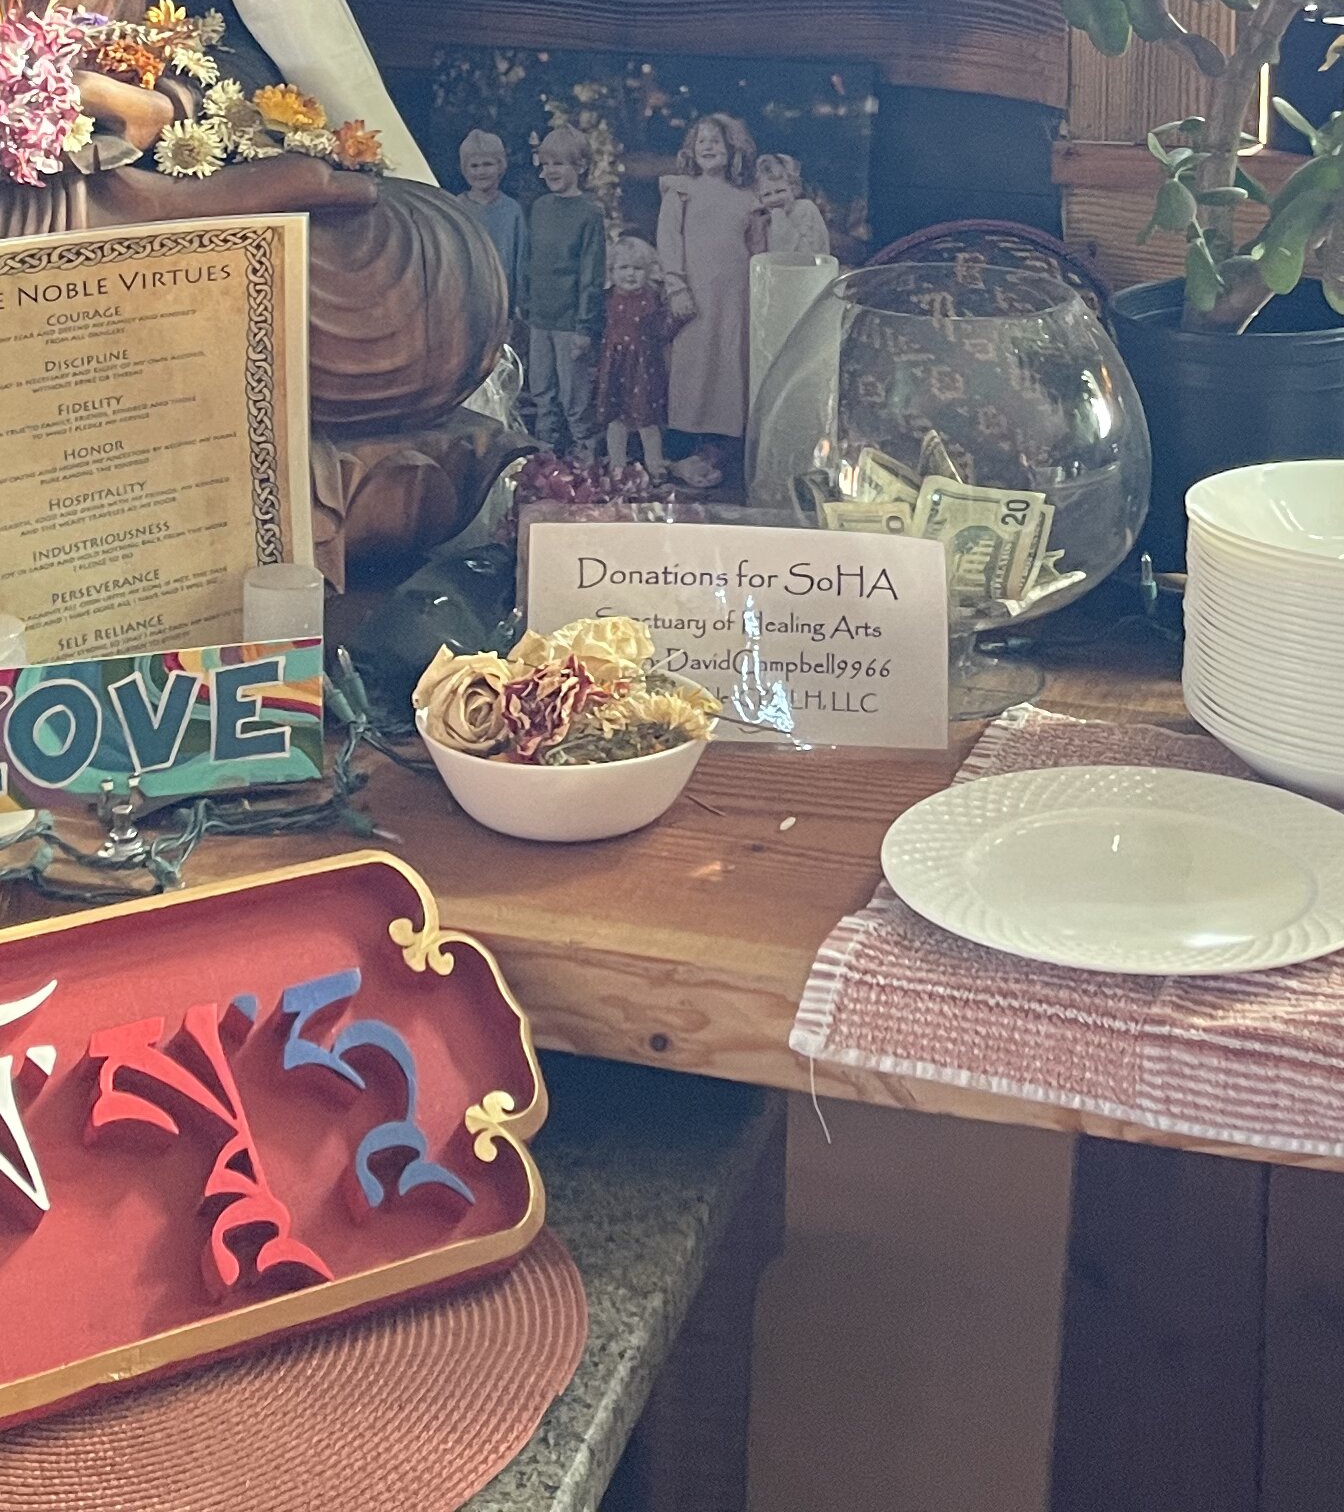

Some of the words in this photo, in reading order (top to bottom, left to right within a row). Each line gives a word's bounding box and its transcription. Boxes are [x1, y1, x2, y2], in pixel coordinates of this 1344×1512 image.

[17, 278, 107, 307] NOBLE
[118, 263, 232, 292] VIRTUES
[46, 305, 121, 327] COURAGE
[44, 348, 129, 373] DISCIPLINE
[57, 394, 124, 416] FIDELITY
[64, 440, 124, 462] HONOR
[48, 481, 147, 511] HOSPITALITY
[1001, 499, 1030, 527] 20
[32, 520, 170, 563] INDUSTRIOUSNESS
[51, 569, 160, 605] PERSEVERANCE
[577, 557, 728, 590] Donations
[736, 560, 779, 589] for
[783, 563, 899, 601] SoHA
[58, 632, 89, 652] SELF
[94, 614, 165, 642] RELIANCE
[713, 610, 735, 632] of
[830, 616, 882, 639] Arts
[832, 692, 878, 712] LLC
